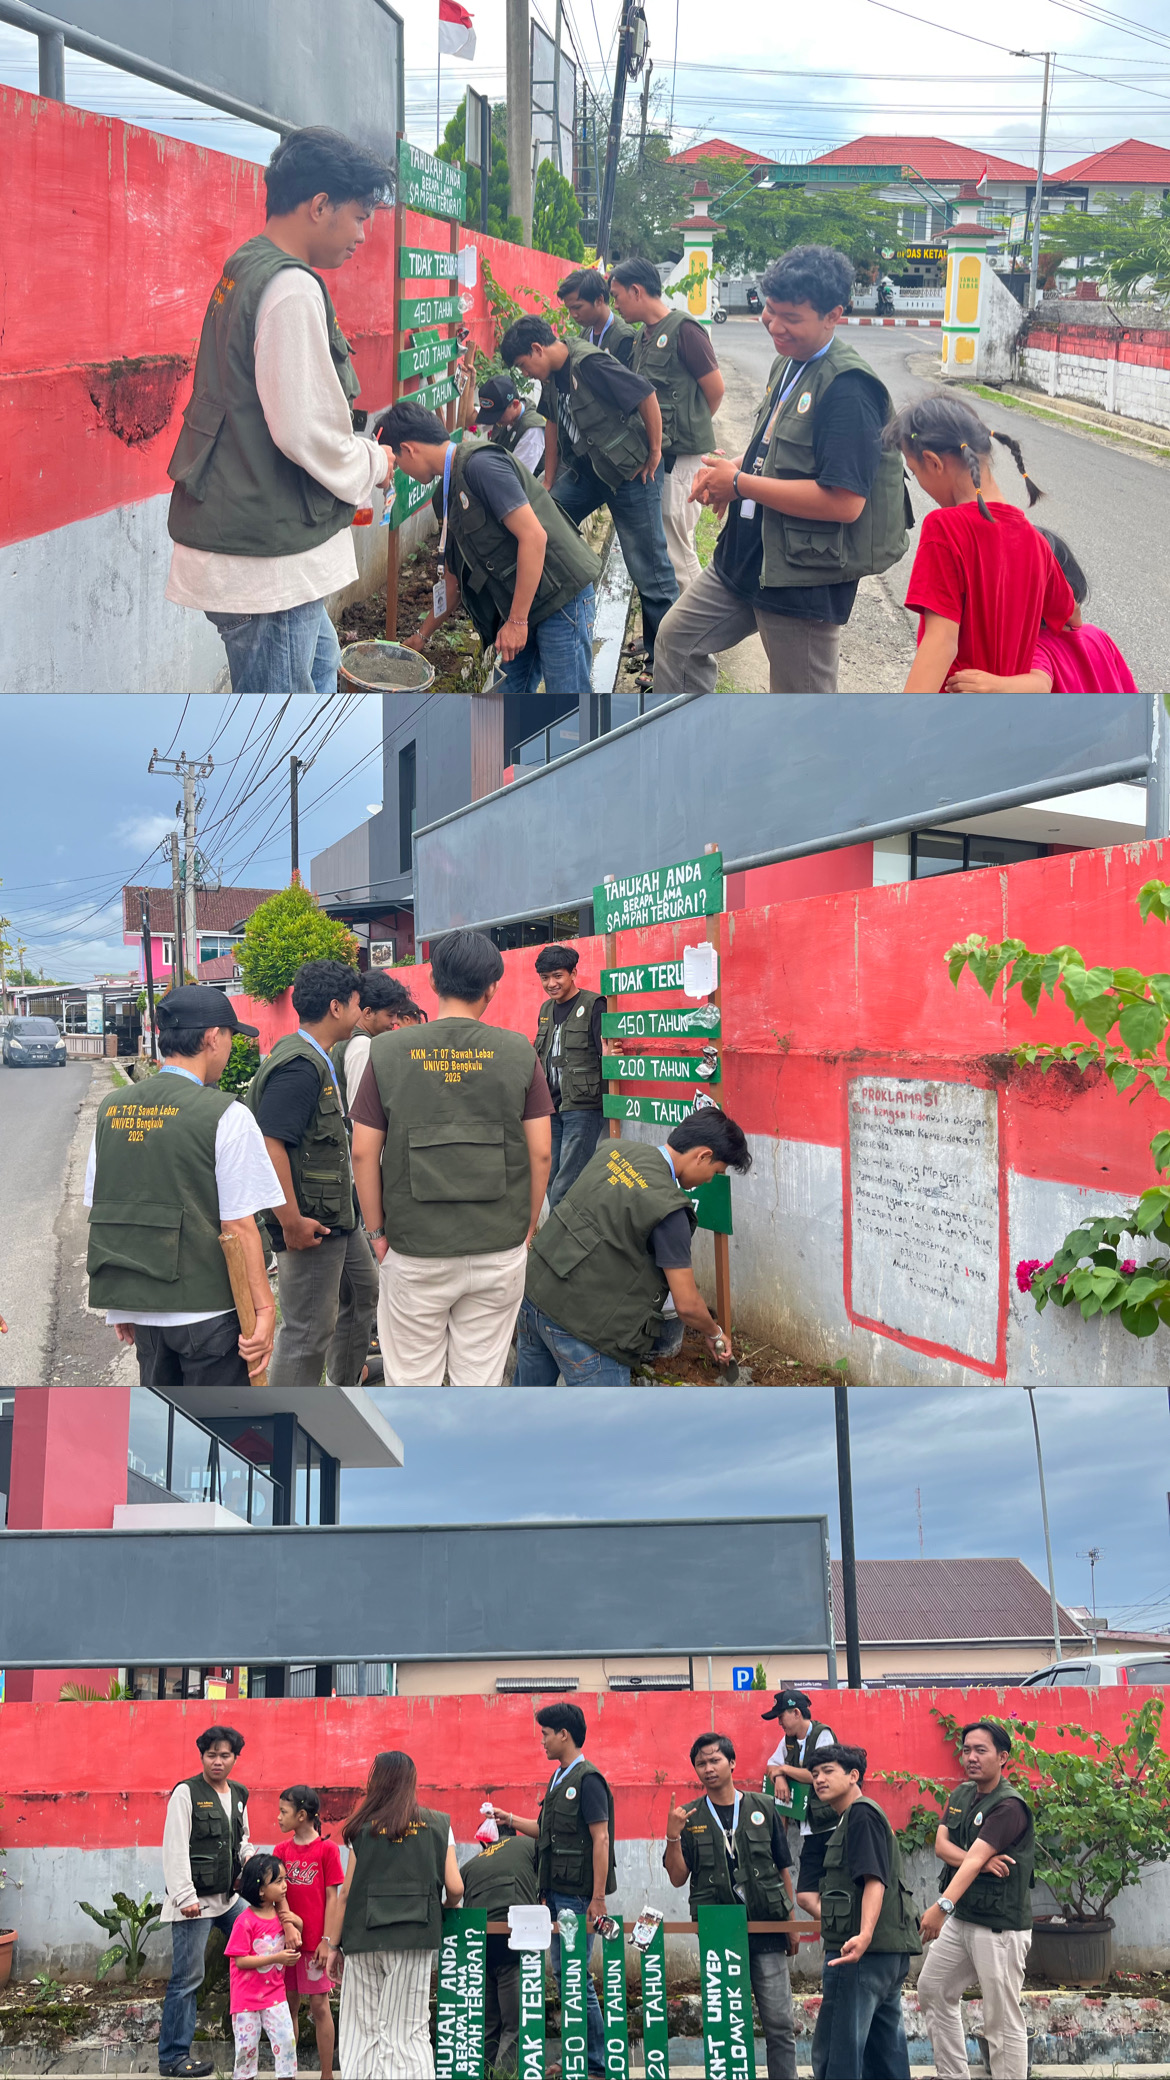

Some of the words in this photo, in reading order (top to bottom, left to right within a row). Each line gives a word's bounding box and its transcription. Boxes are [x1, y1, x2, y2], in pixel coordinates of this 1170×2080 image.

[410, 146, 443, 181] TAHUKAH
[445, 167, 460, 190] ANDA
[422, 175, 440, 193] BERAPA
[440, 181, 453, 196] LAMA
[409, 182, 437, 208] SAMPAH
[437, 195, 462, 219] TERURAI?
[409, 253, 433, 277] TIDAK
[414, 302, 432, 324] 450
[433, 301, 453, 320] TAHUN
[413, 347, 429, 371] 200
[432, 344, 452, 364] TAHUN
[432, 382, 452, 406] TAHUN
[604, 871, 660, 901] TAHUKAH
[666, 863, 702, 888] ANDA
[606, 908, 648, 932] SAMPAH
[650, 889, 706, 922] TERURAI?
[623, 894, 654, 912] BERAPA
[656, 886, 682, 904] LAMA
[609, 969, 644, 992] TIDAK
[617, 1014, 645, 1035] 450
[648, 1014, 688, 1033] TAHUN
[410, 1049, 426, 1059] KKN
[433, 1049, 438, 1059] T
[440, 1048, 449, 1059] 07
[451, 1048, 473, 1059] Sawah
[475, 1048, 494, 1059] Lebar
[423, 1060, 449, 1071] UNIVED
[451, 1060, 483, 1073] Bengkulu
[445, 1072, 461, 1082] 2025
[618, 1058, 645, 1077] 200
[650, 1060, 690, 1078] TAHUN
[106, 1105, 118, 1116] KKN
[138, 1104, 158, 1116] Sawah
[160, 1104, 179, 1116] Lebar
[626, 1099, 640, 1117] 20
[111, 1117, 134, 1129] UNIVED
[136, 1117, 163, 1131] Bengkulu
[128, 1130, 144, 1142] 2025
[737, 1670, 750, 1689] P
[441, 1935, 458, 1991] ANDA
[465, 1928, 485, 2020] TERURAI?
[725, 1948, 742, 1976] 07
[456, 1965, 468, 2008] LAMA
[564, 1959, 583, 2028] TAHUN
[607, 1959, 625, 2028] TAHUN
[645, 1954, 665, 2028] TAHUN
[706, 1949, 722, 2022] UNIVED
[455, 2014, 468, 2072] BERAPA
[647, 2049, 666, 2079] 20
